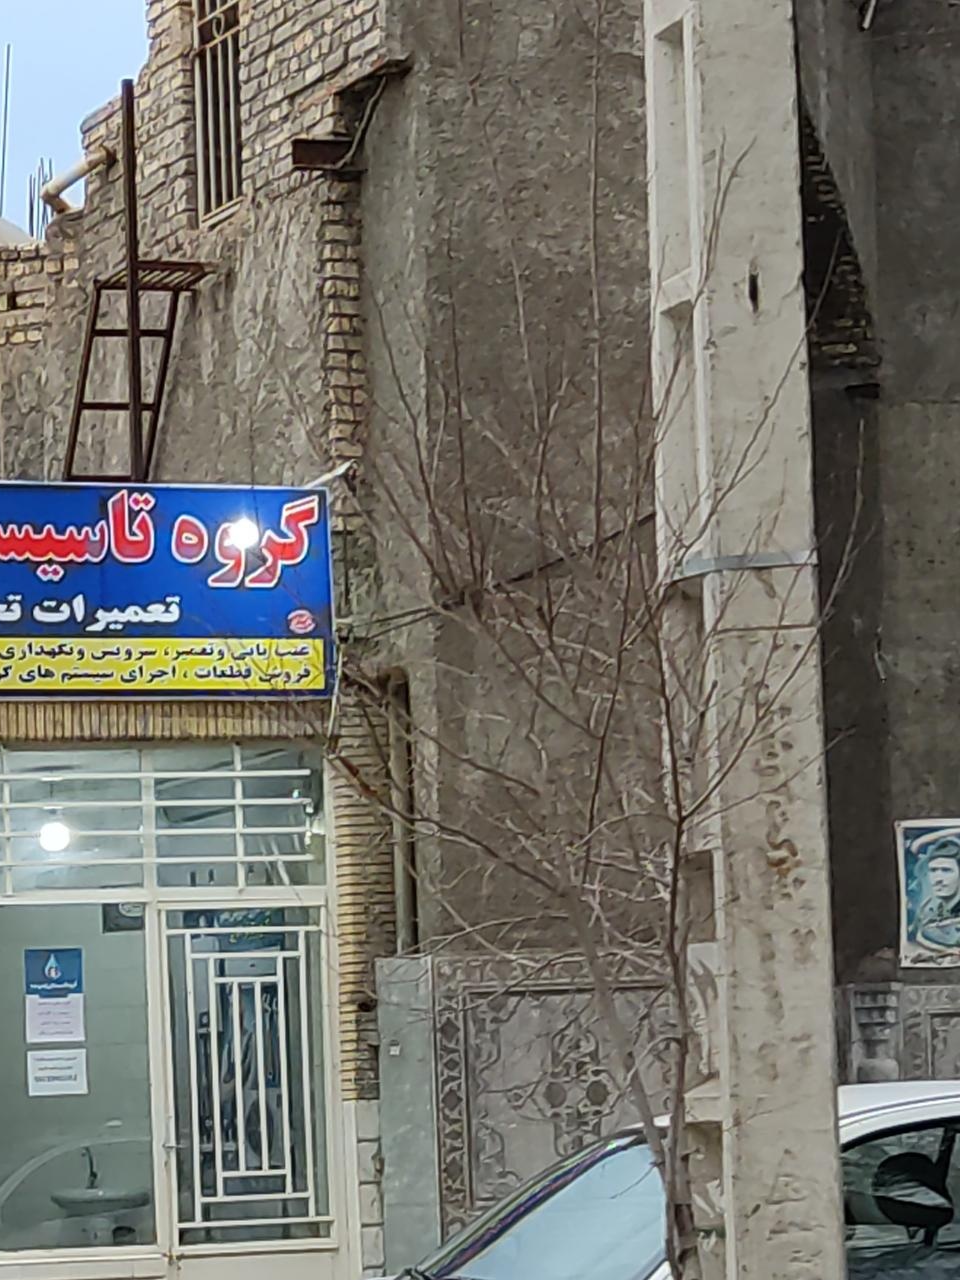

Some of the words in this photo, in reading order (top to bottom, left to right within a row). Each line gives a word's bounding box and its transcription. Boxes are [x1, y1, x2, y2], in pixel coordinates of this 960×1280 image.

[171, 494, 321, 588] گروه
[32, 594, 181, 632] تعمیرات
[19, 664, 55, 682] های
[61, 665, 114, 682] سیستم
[120, 665, 177, 684] اجرای
[195, 665, 252, 680] قطعات
